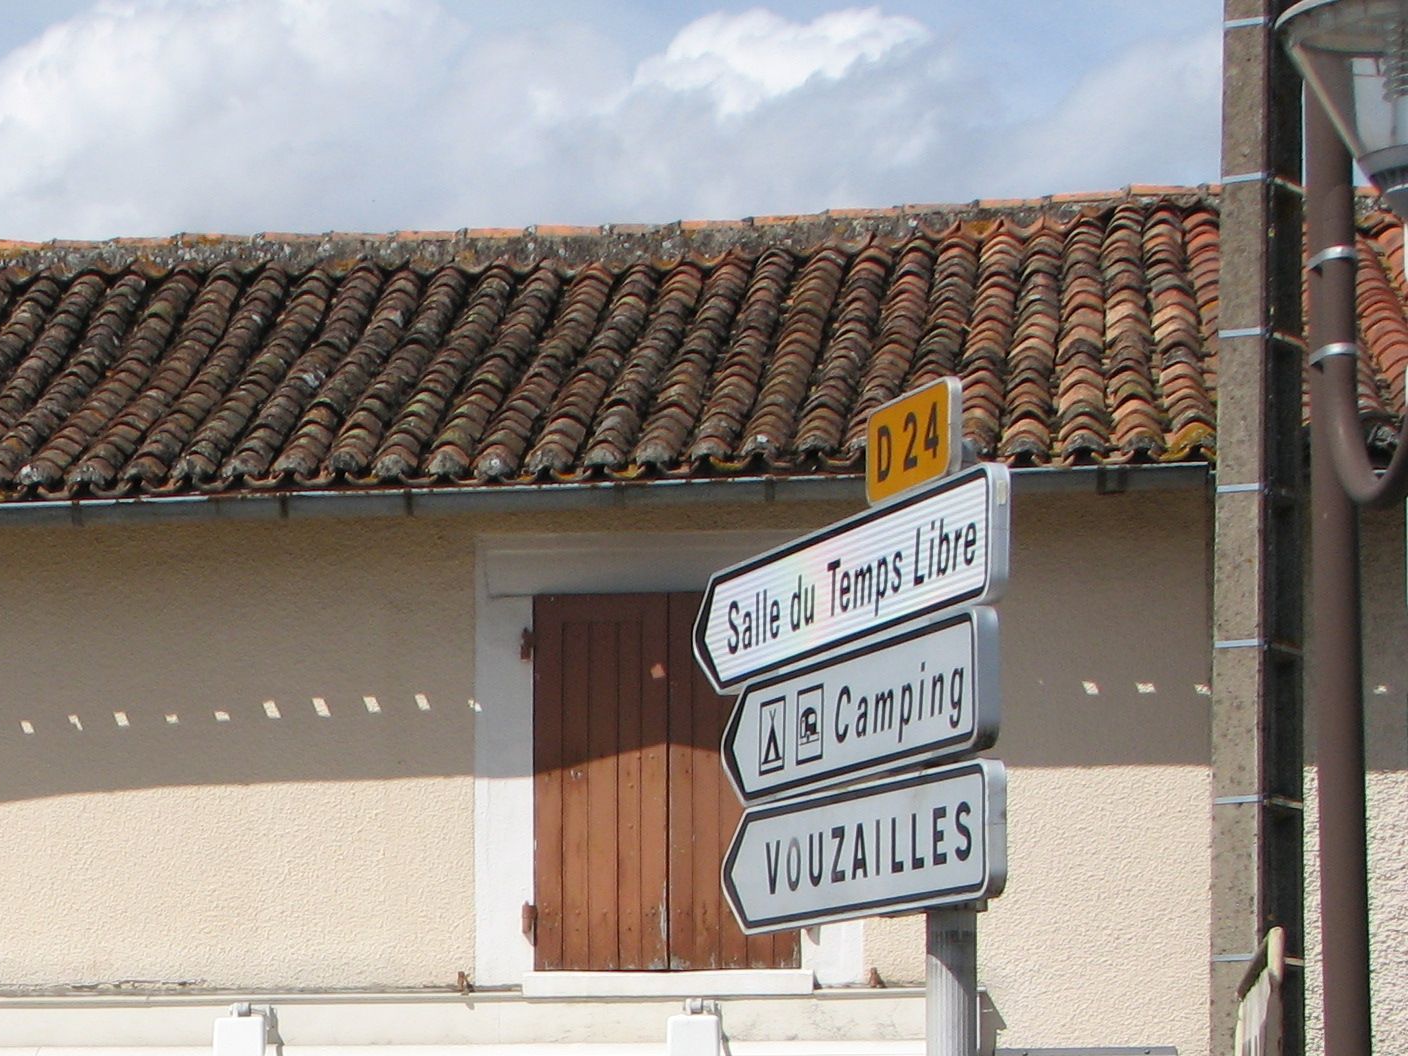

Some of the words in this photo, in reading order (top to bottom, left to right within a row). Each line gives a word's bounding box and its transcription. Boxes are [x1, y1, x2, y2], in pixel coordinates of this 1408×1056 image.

[875, 423, 893, 483] D
[901, 401, 941, 474] 24
[726, 583, 782, 656] Salle
[789, 574, 816, 620] du
[827, 552, 903, 616] Temps
[912, 518, 978, 586] Libre
[834, 660, 965, 743] Camping
[765, 800, 973, 895] VOUZAILLES
